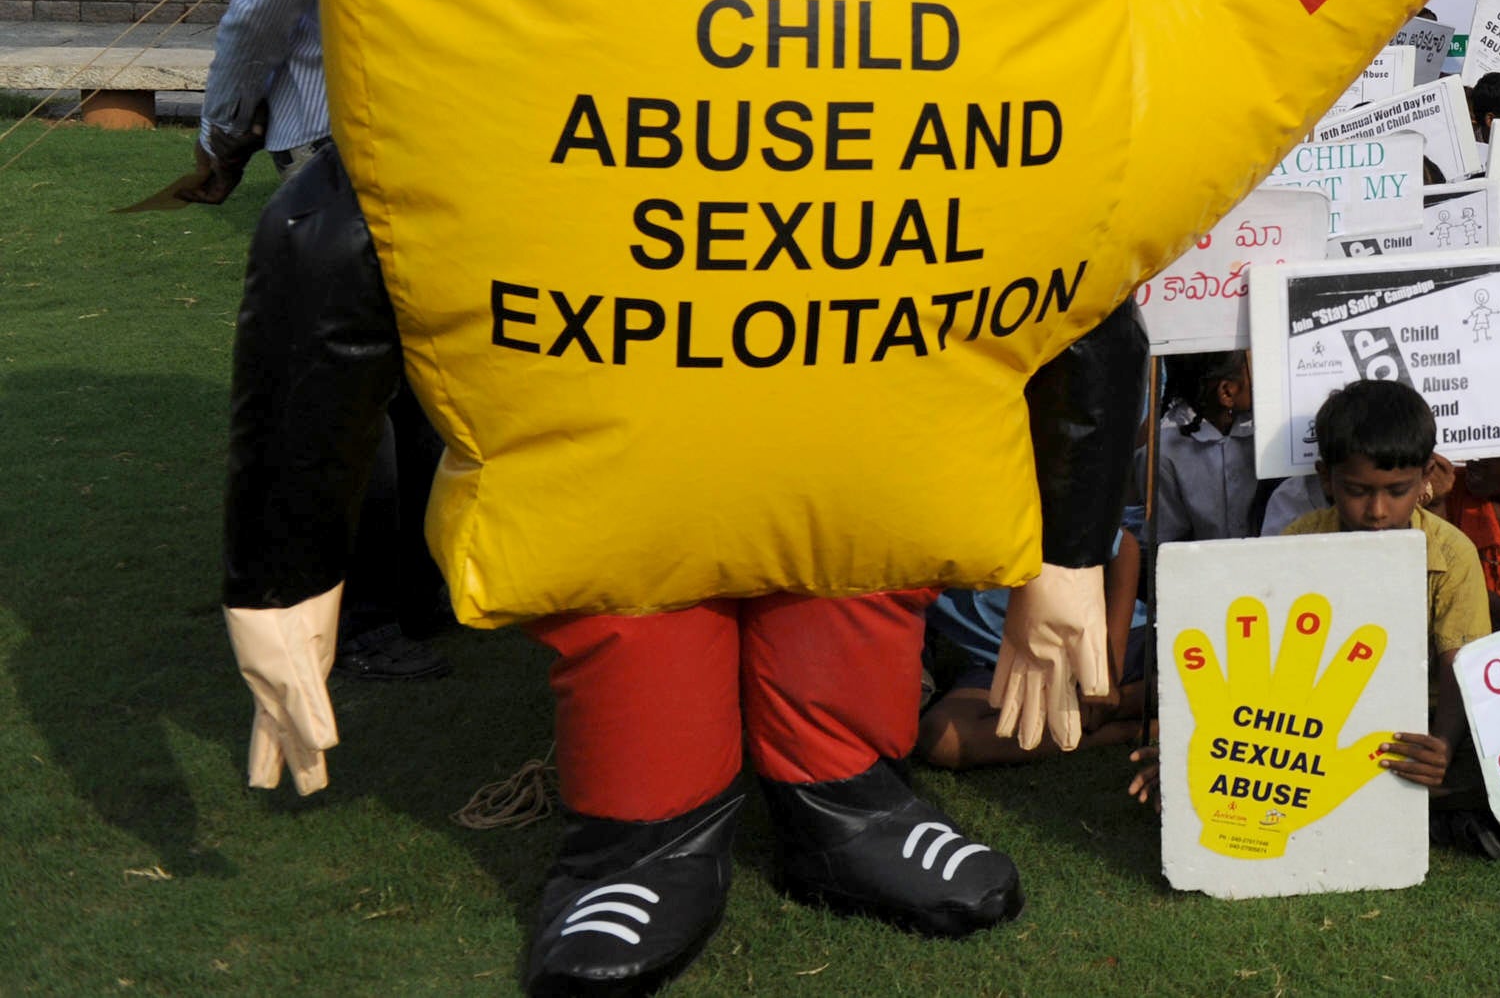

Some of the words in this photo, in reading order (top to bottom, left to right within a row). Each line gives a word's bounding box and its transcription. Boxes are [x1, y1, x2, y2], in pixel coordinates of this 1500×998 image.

[550, 94, 874, 171] ABUSE
[899, 100, 1062, 170] AND
[1320, 128, 1339, 141] 10th
[1341, 114, 1373, 134] Annual
[1374, 104, 1402, 122] World
[1403, 98, 1421, 111] Day
[1422, 93, 1436, 105] For
[1387, 114, 1411, 130] Child
[1412, 105, 1441, 120] Abuse
[1296, 142, 1385, 173] CHILD
[1364, 174, 1408, 200] MY
[629, 197, 984, 271] SEXUAL
[1384, 280, 1435, 303] Campaign
[491, 260, 1087, 368] EXPLOITATION
[1400, 325, 1439, 343] Child
[1410, 349, 1461, 368] Sexual
[1422, 377, 1469, 393] Abuse
[1432, 401, 1459, 417] and
[1233, 705, 1324, 739] CHILD
[1210, 738, 1326, 776] SEXUAL
[1209, 774, 1311, 809] ABUSE
